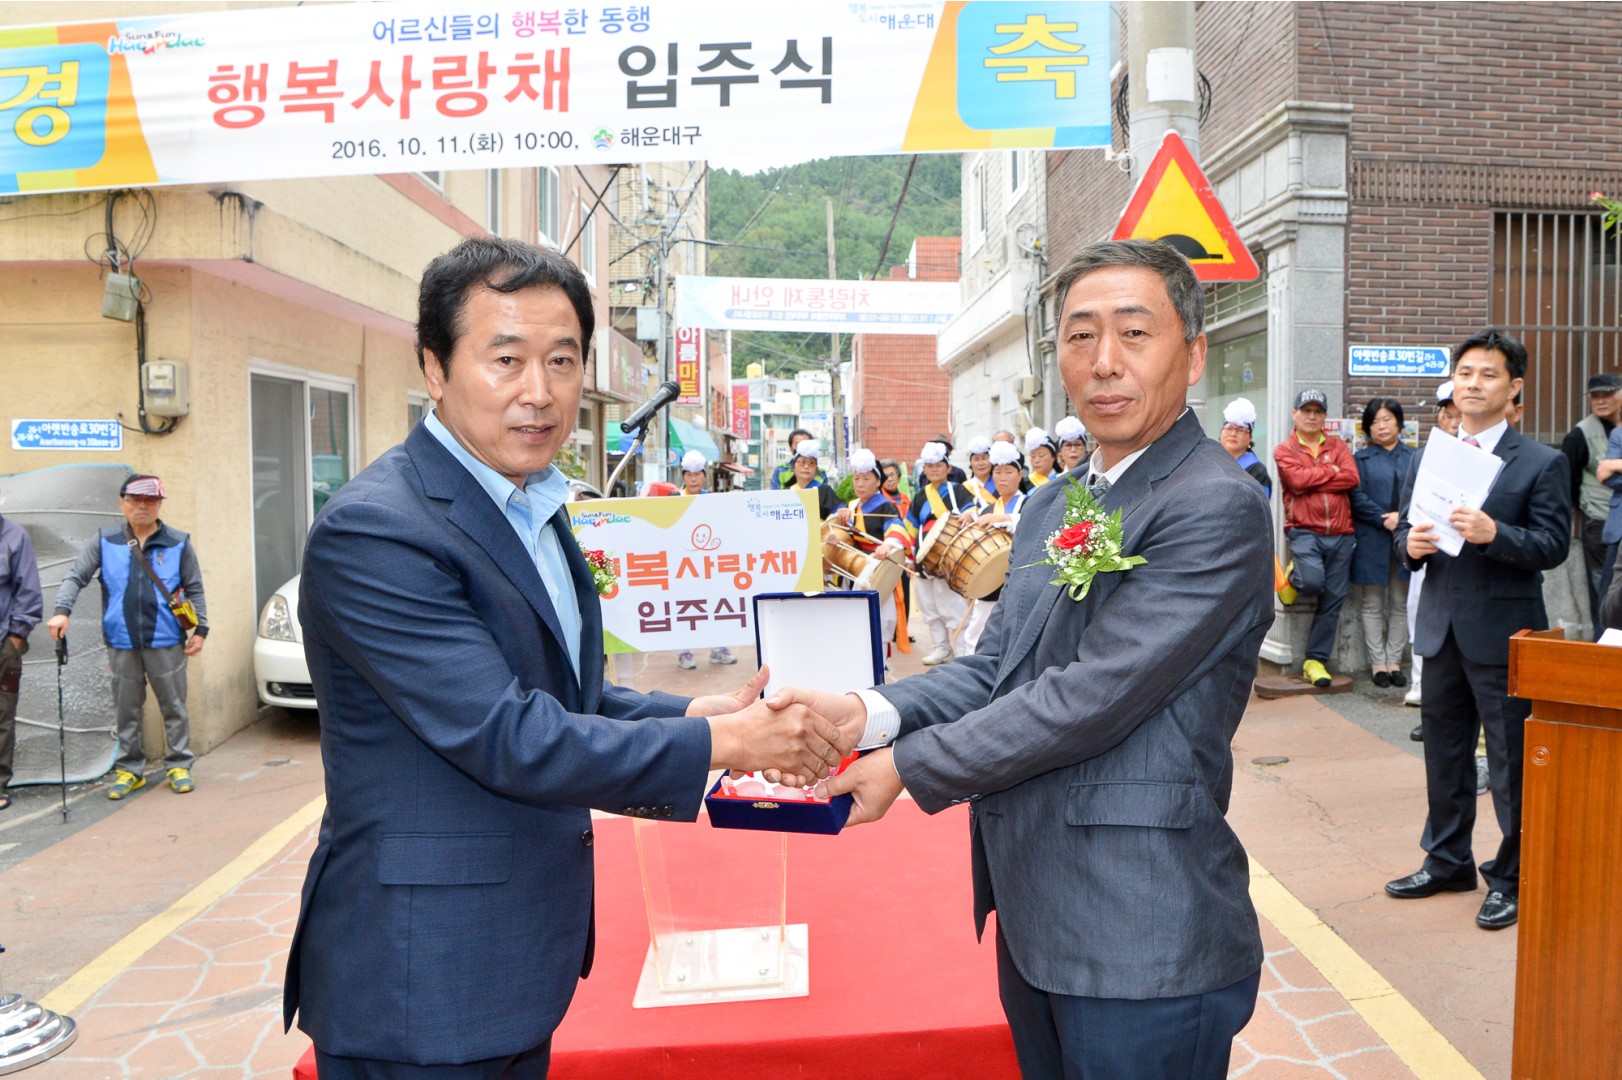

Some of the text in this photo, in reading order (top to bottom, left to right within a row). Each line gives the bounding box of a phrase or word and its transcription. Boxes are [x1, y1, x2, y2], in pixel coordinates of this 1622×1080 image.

[373, 5, 651, 45] 어르신들의 행복한 동행
[879, 13, 934, 30] 해운대
[109, 33, 206, 55] Haeundae
[125, 30, 176, 41] Sun&Fun
[983, 14, 1090, 99] 축
[207, 36, 833, 129] 행복사랑채 입주식
[0, 60, 79, 147] 경
[332, 139, 387, 159] 2016.
[397, 137, 427, 157] 10.
[437, 132, 504, 156] 11.(화)
[619, 125, 703, 148] 해운대구
[1353, 350, 1424, 363] 아랫반송로30번길
[41, 423, 118, 437] 아랫반송로30번길
[572, 514, 631, 528] Haeundae
[581, 511, 612, 519] Sun&Fun
[770, 508, 804, 520] 해운대
[638, 597, 747, 633] 입주식
